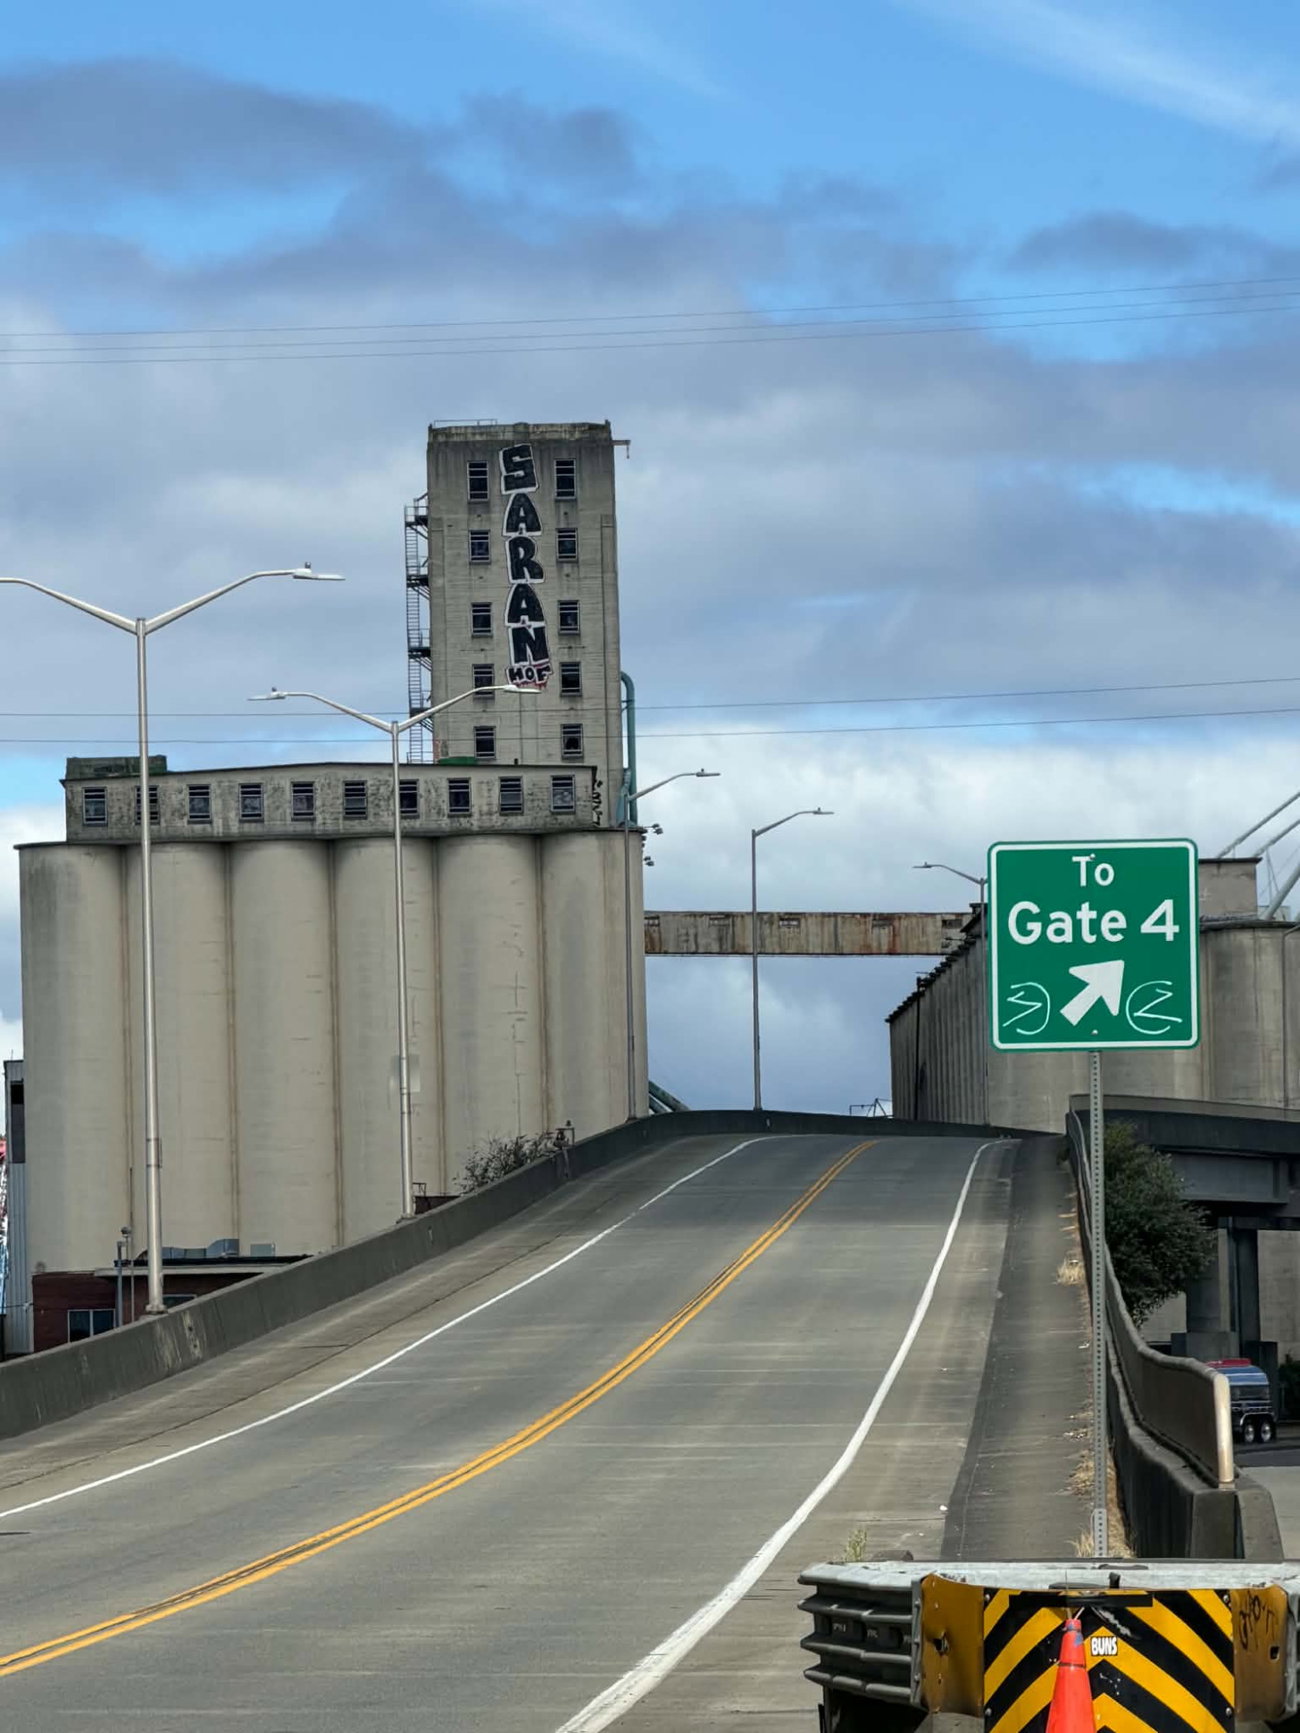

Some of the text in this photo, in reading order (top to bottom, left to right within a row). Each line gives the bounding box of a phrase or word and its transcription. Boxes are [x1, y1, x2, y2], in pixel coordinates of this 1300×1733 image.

[500, 444, 549, 665] SARAN
[1072, 855, 1115, 887] To
[1008, 899, 1180, 945] Gate 4
[1091, 1636, 1118, 1656] BUNS
